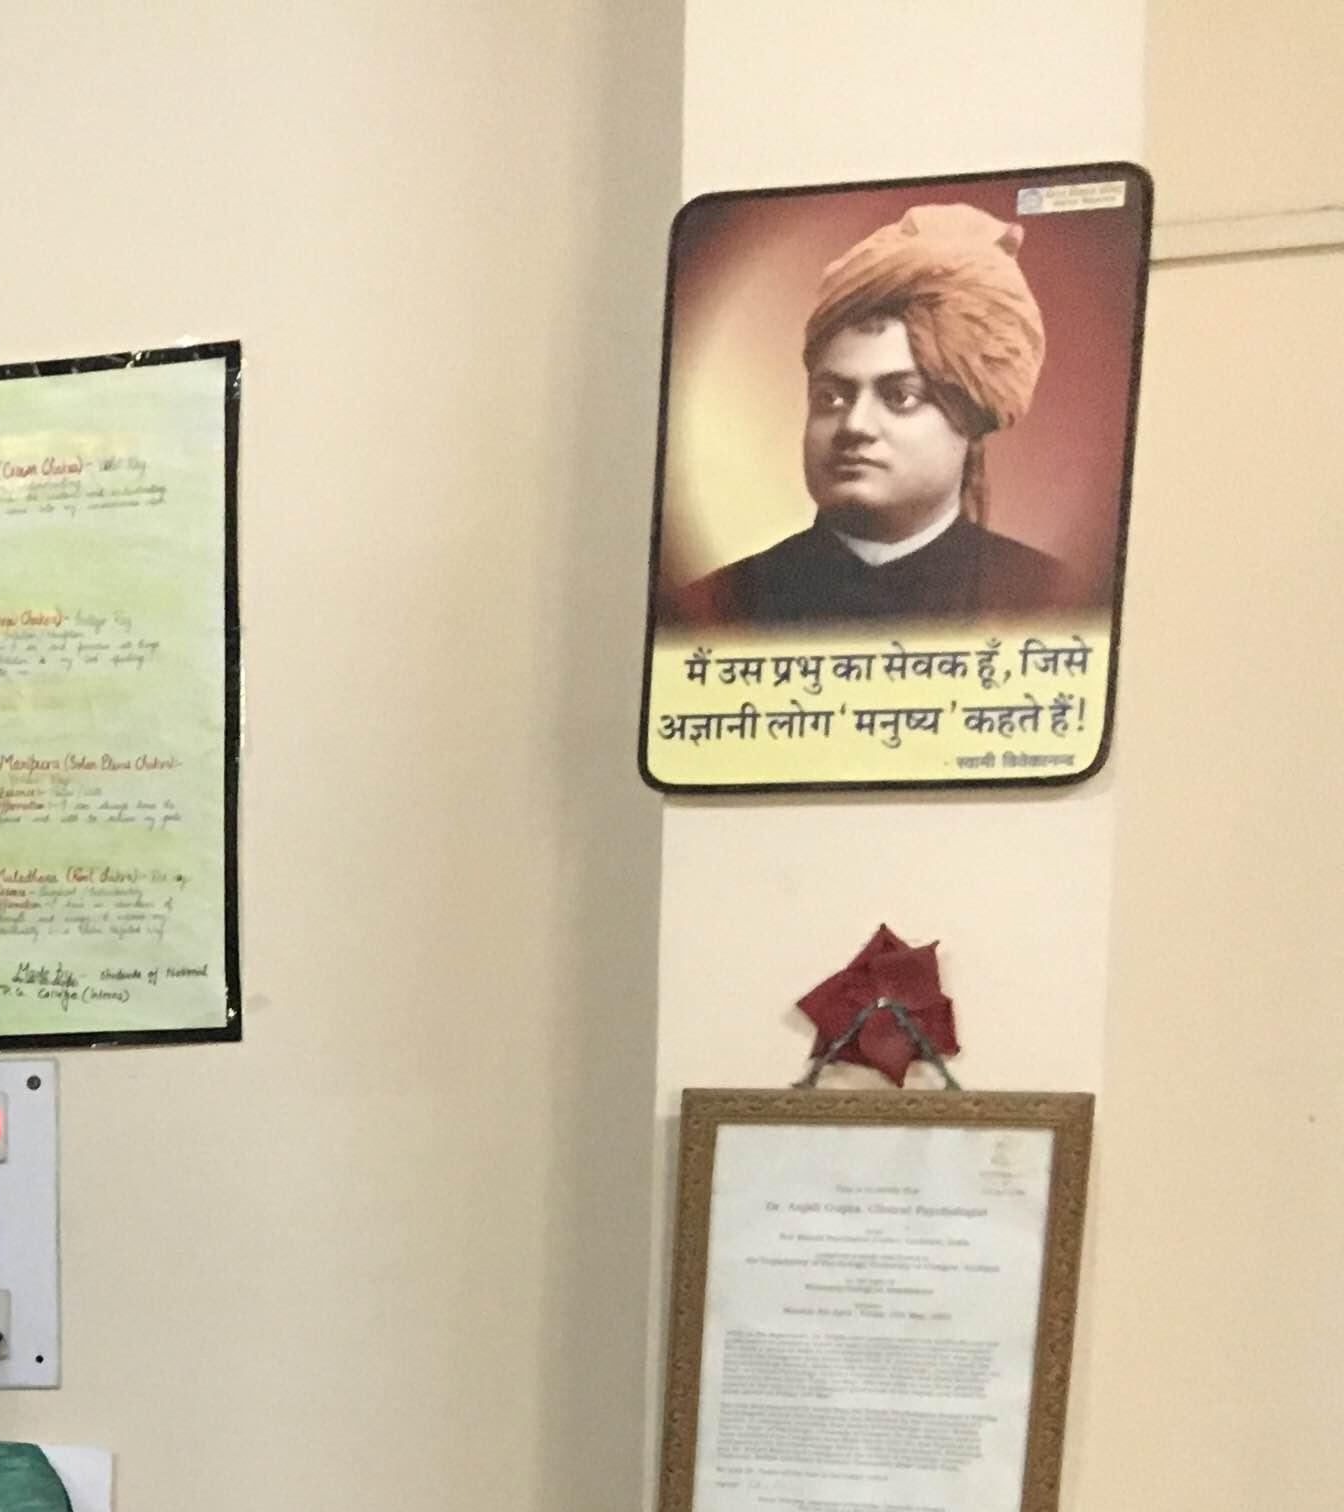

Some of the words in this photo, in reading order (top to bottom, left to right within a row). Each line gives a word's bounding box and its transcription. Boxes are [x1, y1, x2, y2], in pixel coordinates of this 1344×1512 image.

[684, 647, 713, 686] मैं
[716, 656, 763, 686] उस
[773, 653, 826, 694] प्रभु
[831, 652, 875, 682] का
[882, 641, 970, 682] सेवक
[1018, 635, 1092, 678] जिसे
[658, 701, 765, 746] अज्ञानी
[765, 700, 834, 738] लोग
[963, 693, 1042, 735] कहते
